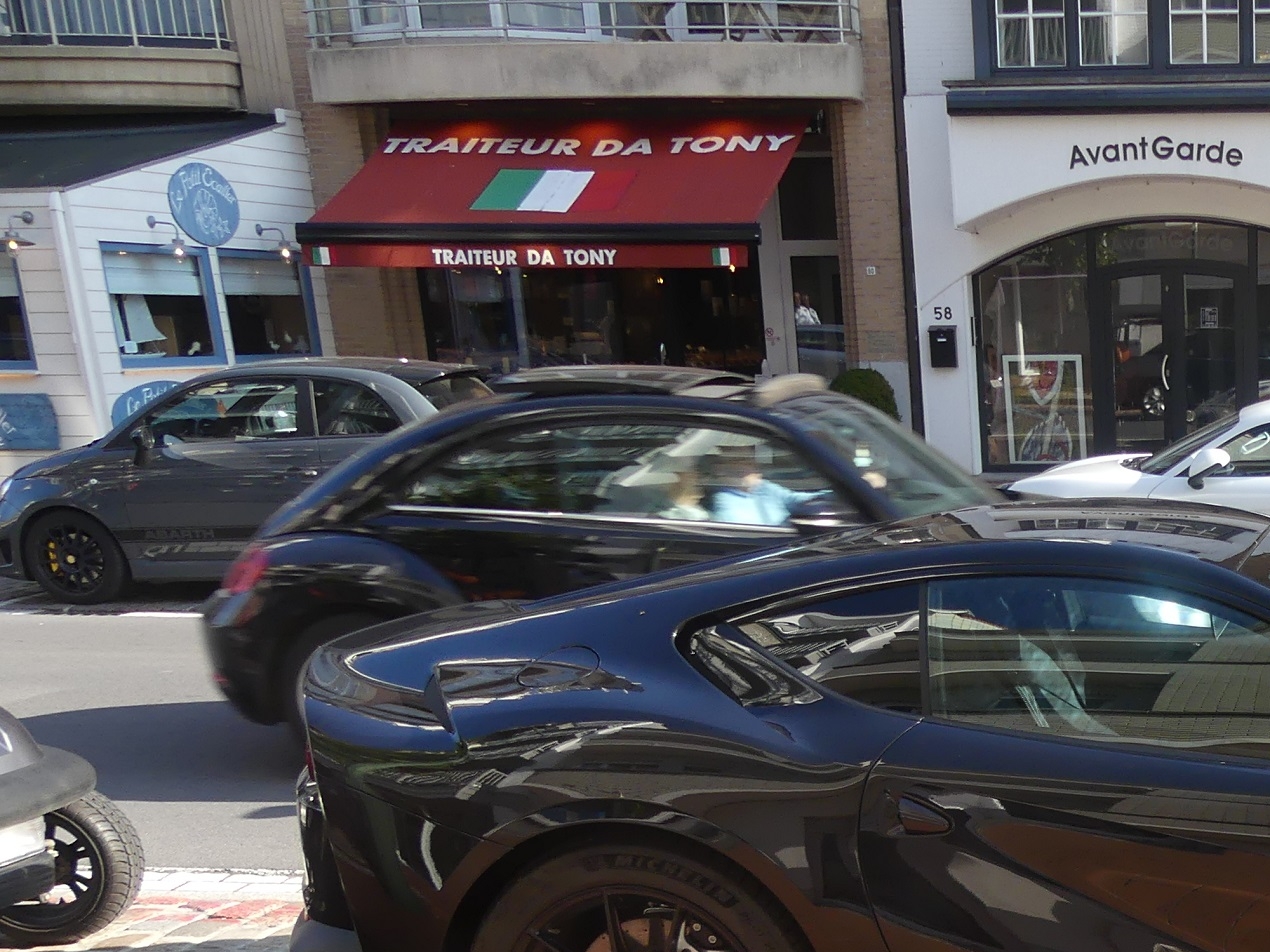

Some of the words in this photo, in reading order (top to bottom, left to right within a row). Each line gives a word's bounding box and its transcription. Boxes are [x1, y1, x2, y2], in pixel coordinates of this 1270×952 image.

[383, 137, 581, 156] TRAITEUR
[591, 138, 653, 156] DA
[670, 134, 796, 153] TONY
[1069, 136, 1243, 170] AvantGarde
[432, 249, 518, 265] TRAITEUR
[527, 250, 555, 265] DA
[564, 249, 617, 266] TONY
[933, 306, 953, 320] 58
